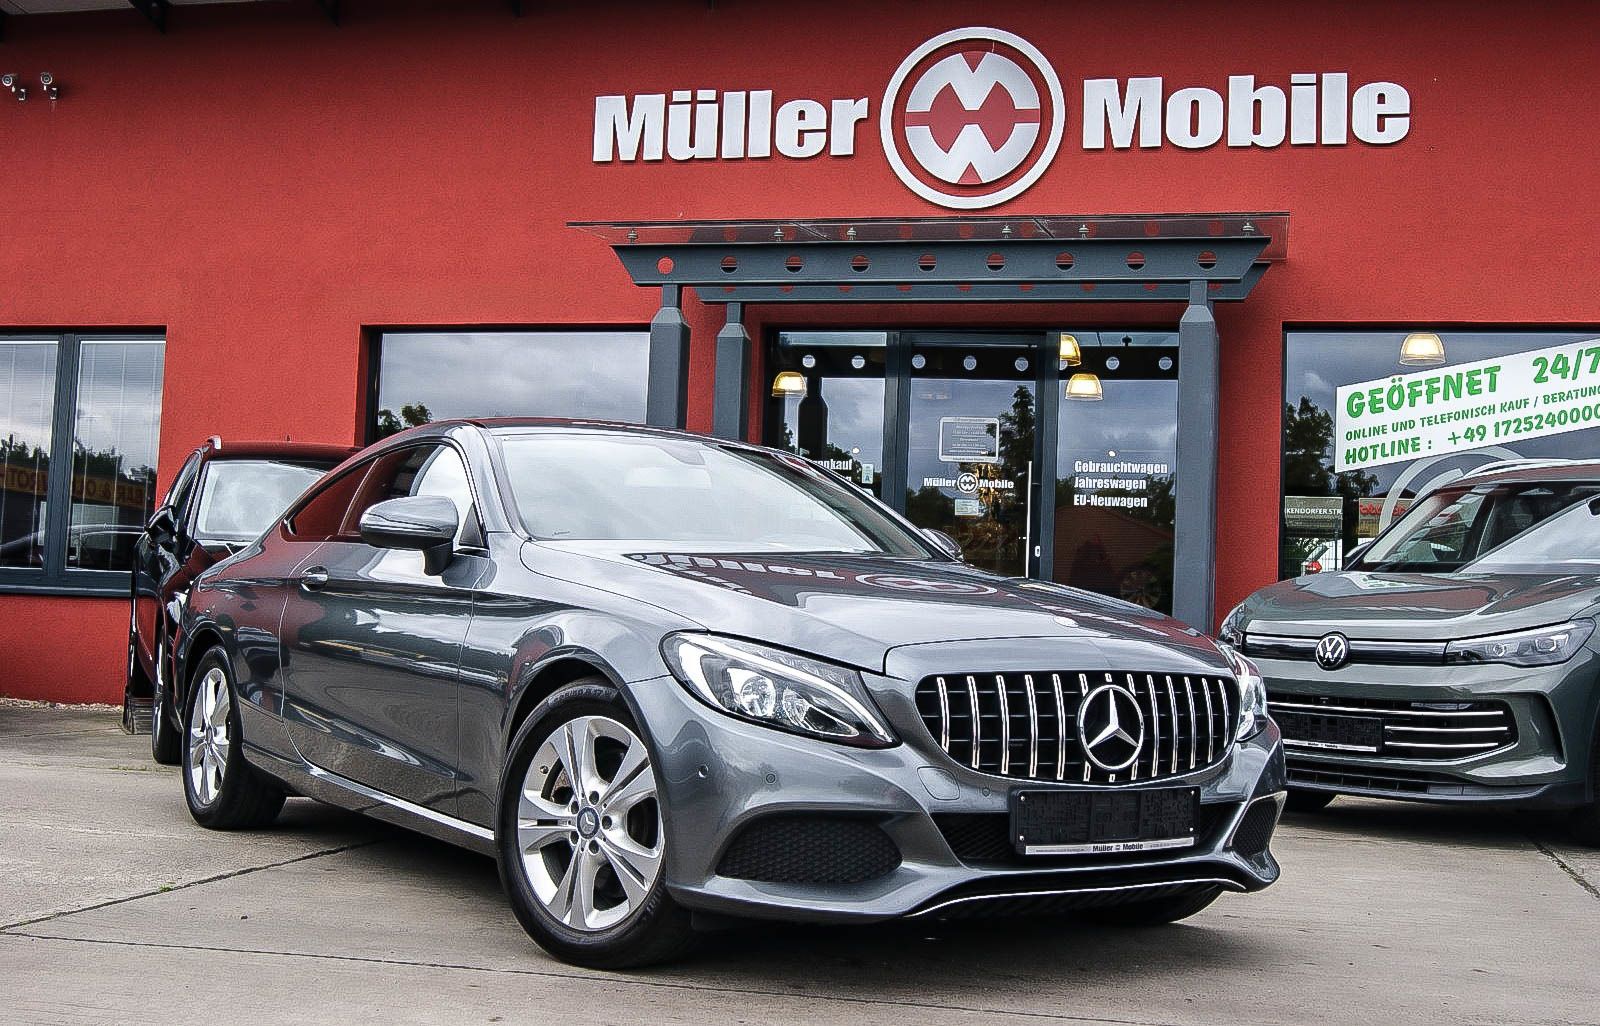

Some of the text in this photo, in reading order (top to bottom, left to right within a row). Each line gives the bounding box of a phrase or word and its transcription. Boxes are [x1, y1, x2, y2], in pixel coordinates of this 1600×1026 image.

[592, 72, 1411, 162] Müller Mobile
[1346, 346, 1600, 418] GEÖFFNET 24/7
[1345, 424, 1388, 442] ONLINE
[1391, 418, 1416, 433] UND
[1420, 403, 1496, 427] TELEFONISCH
[1500, 398, 1530, 413] KAUF
[1345, 436, 1421, 465] HOTLINE
[1447, 424, 1487, 446] +49
[1074, 460, 1168, 475] Gebrauchtwagen
[923, 477, 1015, 489] Müller Mobile
[1074, 477, 1147, 491] Jahreswagen
[1073, 494, 1148, 509] EU-Neuwagen
